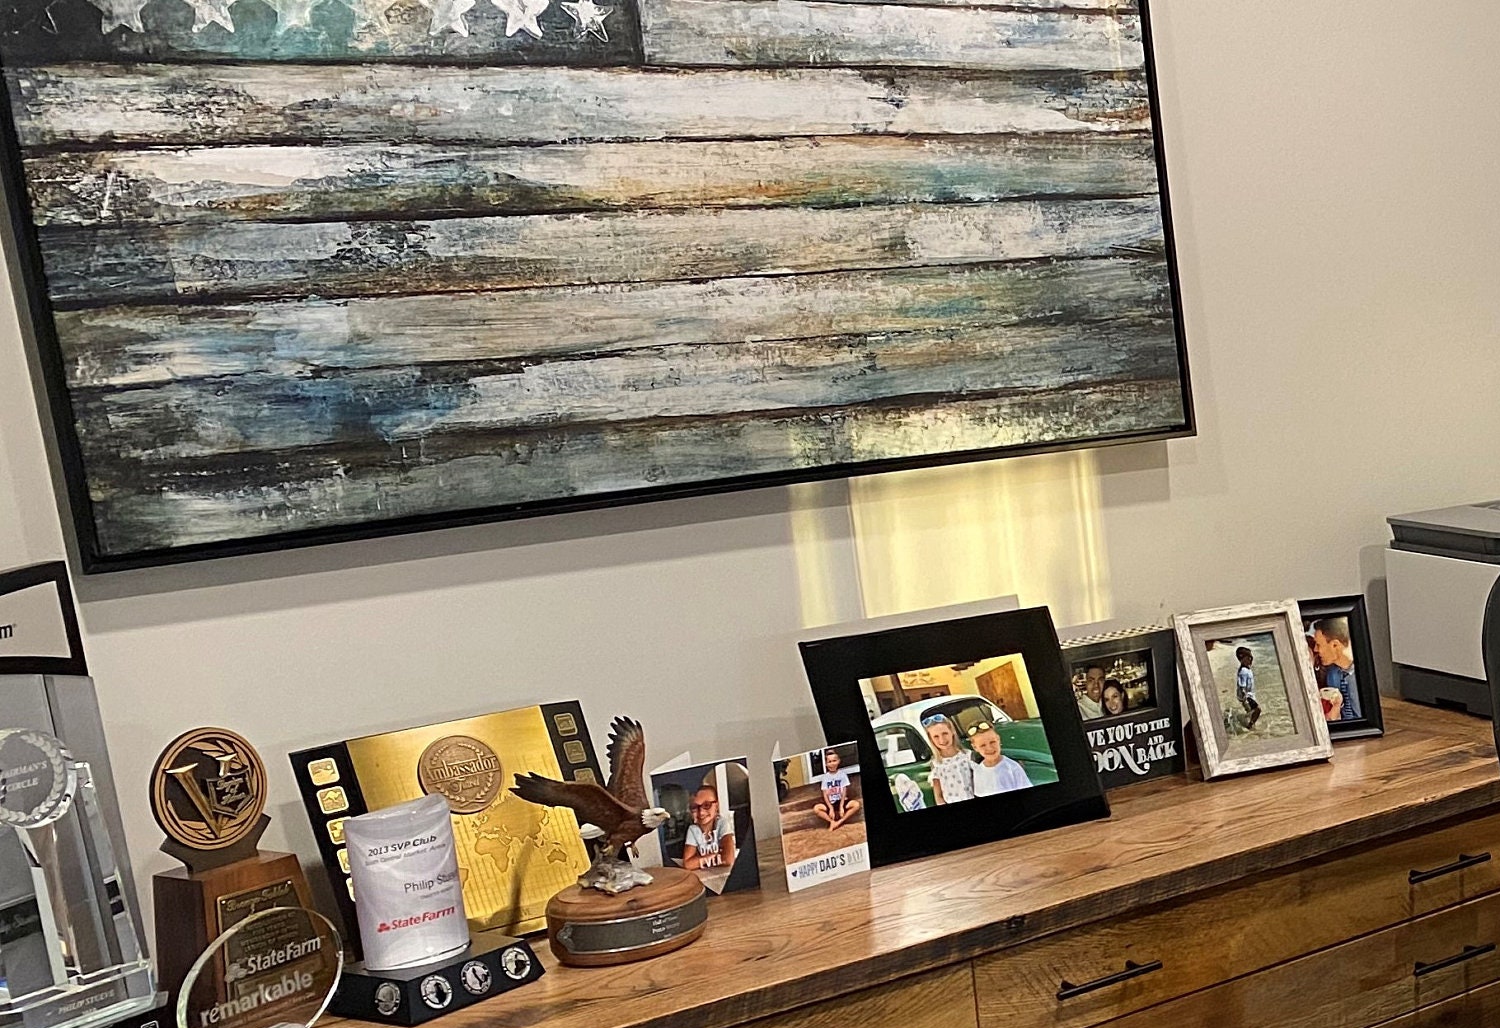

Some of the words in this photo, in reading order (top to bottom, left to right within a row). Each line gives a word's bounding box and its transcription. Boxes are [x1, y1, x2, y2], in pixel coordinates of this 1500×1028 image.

[1106, 722, 1134, 744] YOU
[1134, 723, 1148, 734] TO
[1149, 718, 1170, 731] THE
[1147, 735, 1164, 745] AND
[1136, 741, 1177, 764] BACK
[368, 846, 389, 857] 2013
[391, 841, 411, 851] SVP
[412, 835, 437, 847] Club
[404, 880, 434, 893] Philip
